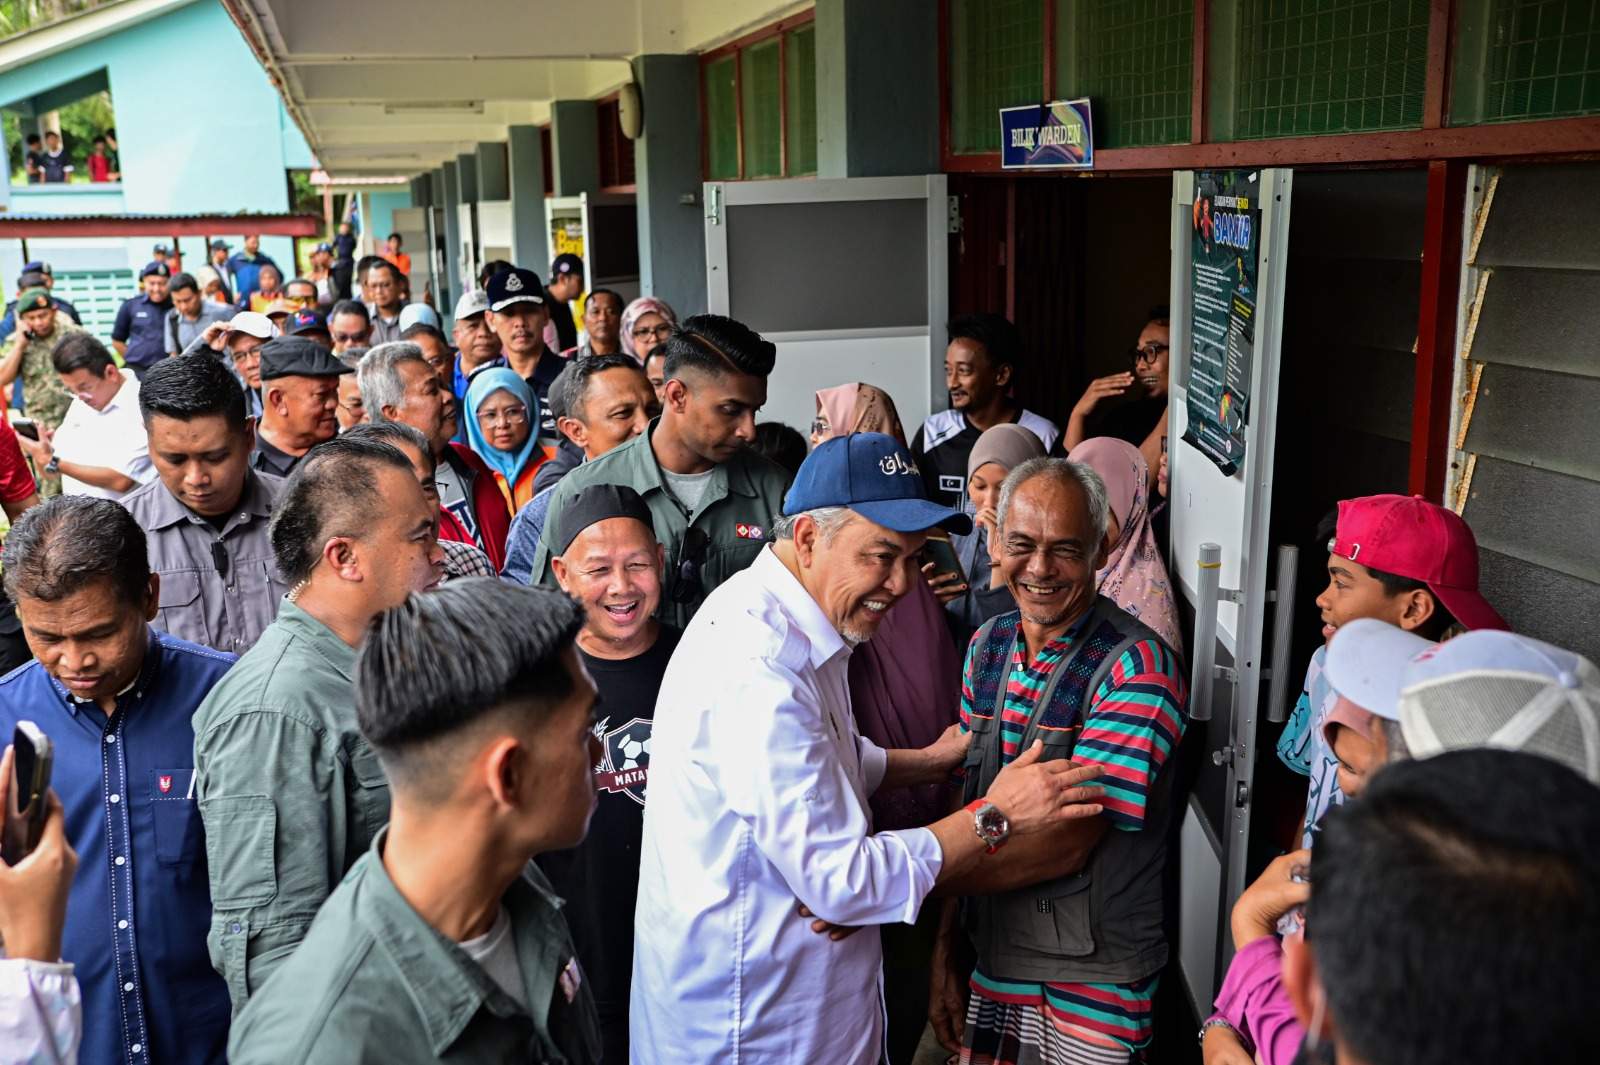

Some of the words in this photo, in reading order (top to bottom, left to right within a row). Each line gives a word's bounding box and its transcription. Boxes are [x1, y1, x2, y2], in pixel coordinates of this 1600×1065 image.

[1011, 127, 1035, 147] BILIK
[1035, 123, 1081, 145] WARDEN
[614, 769, 649, 787] MATA
